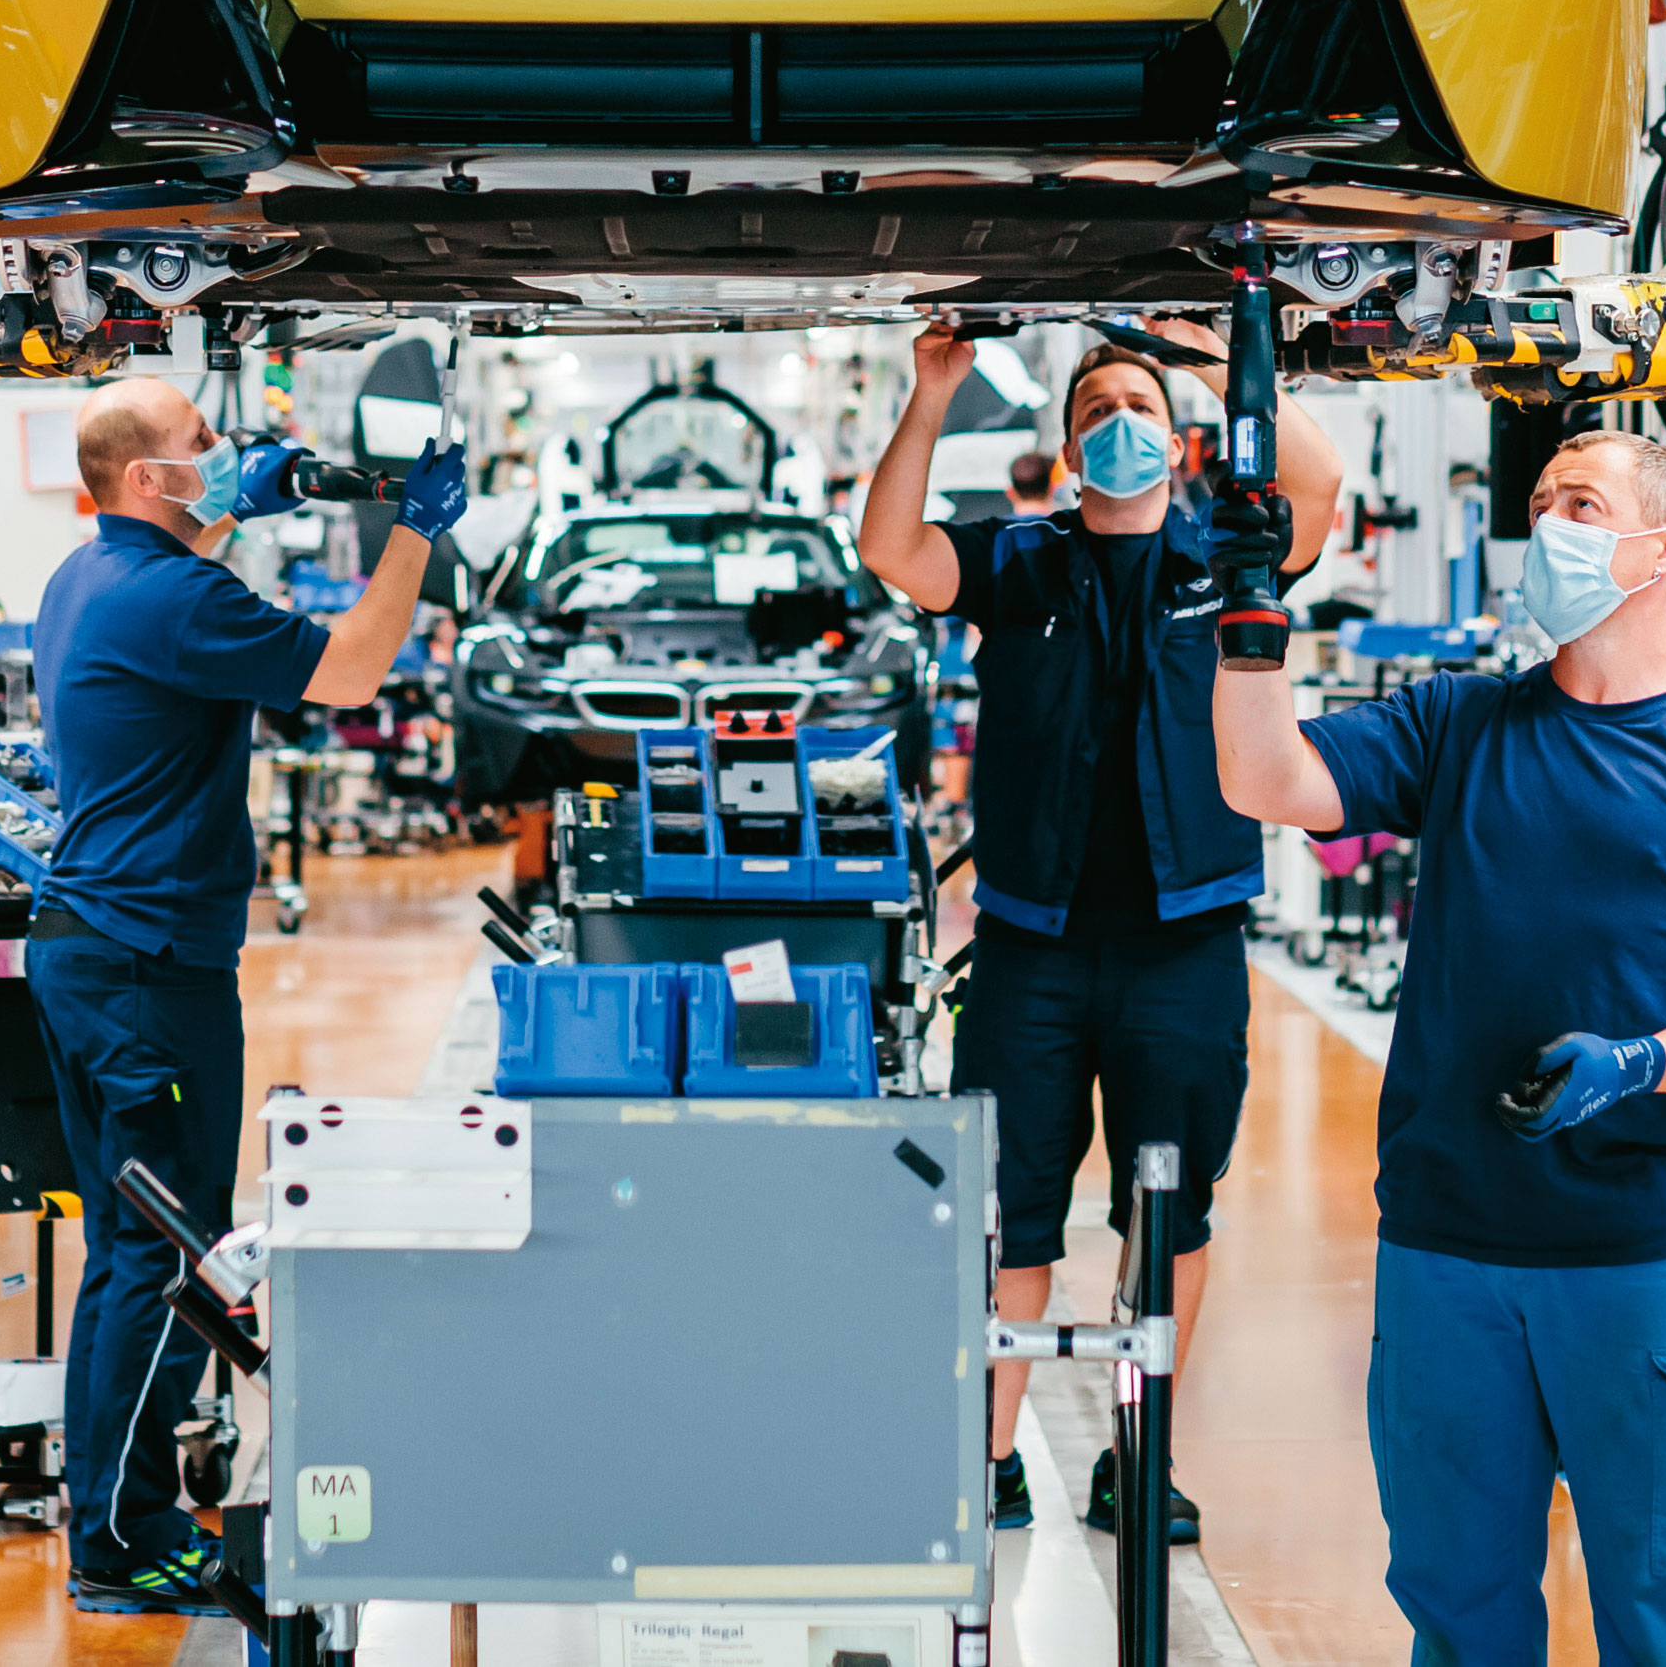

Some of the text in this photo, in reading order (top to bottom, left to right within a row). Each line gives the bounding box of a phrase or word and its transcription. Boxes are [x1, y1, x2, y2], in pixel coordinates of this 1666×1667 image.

[312, 1474, 356, 1496] MA
[328, 1513, 341, 1536] 1
[702, 1623, 745, 1639] Regal
